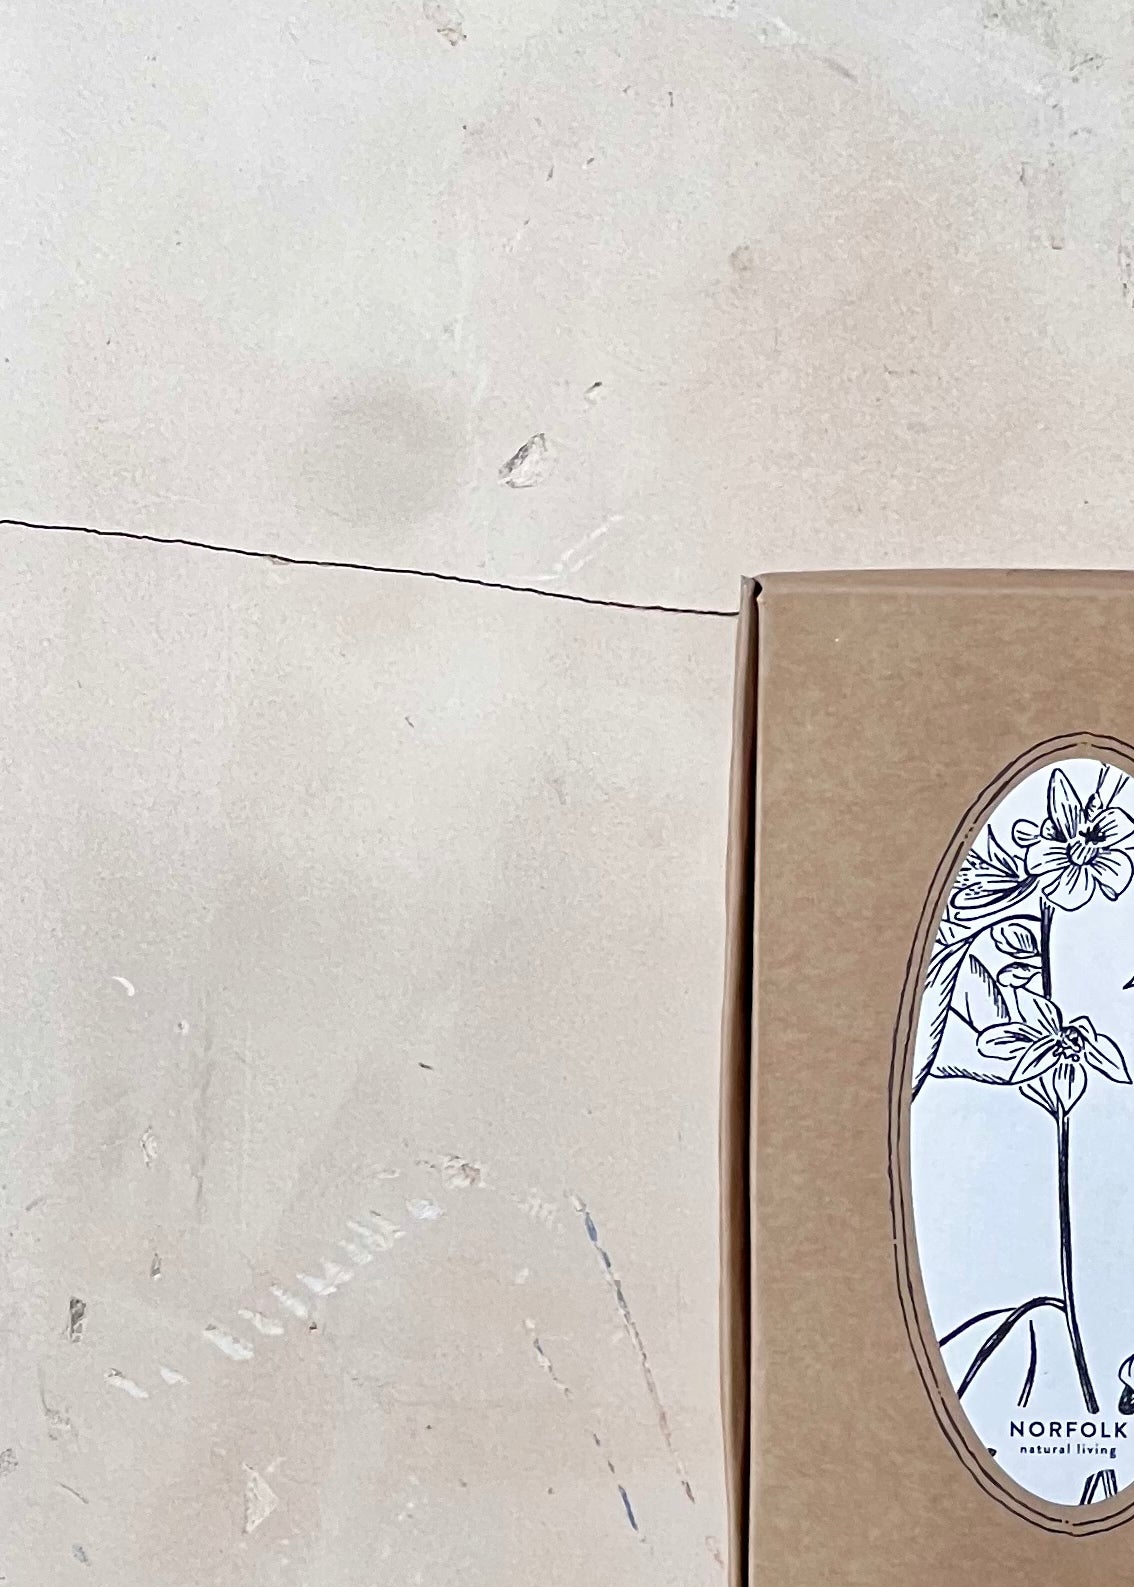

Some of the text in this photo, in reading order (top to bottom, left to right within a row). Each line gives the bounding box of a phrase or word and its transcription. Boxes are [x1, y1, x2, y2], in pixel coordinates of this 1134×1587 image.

[1009, 1420, 1128, 1439] NORFOLK
[1020, 1443, 1117, 1459] natural living
